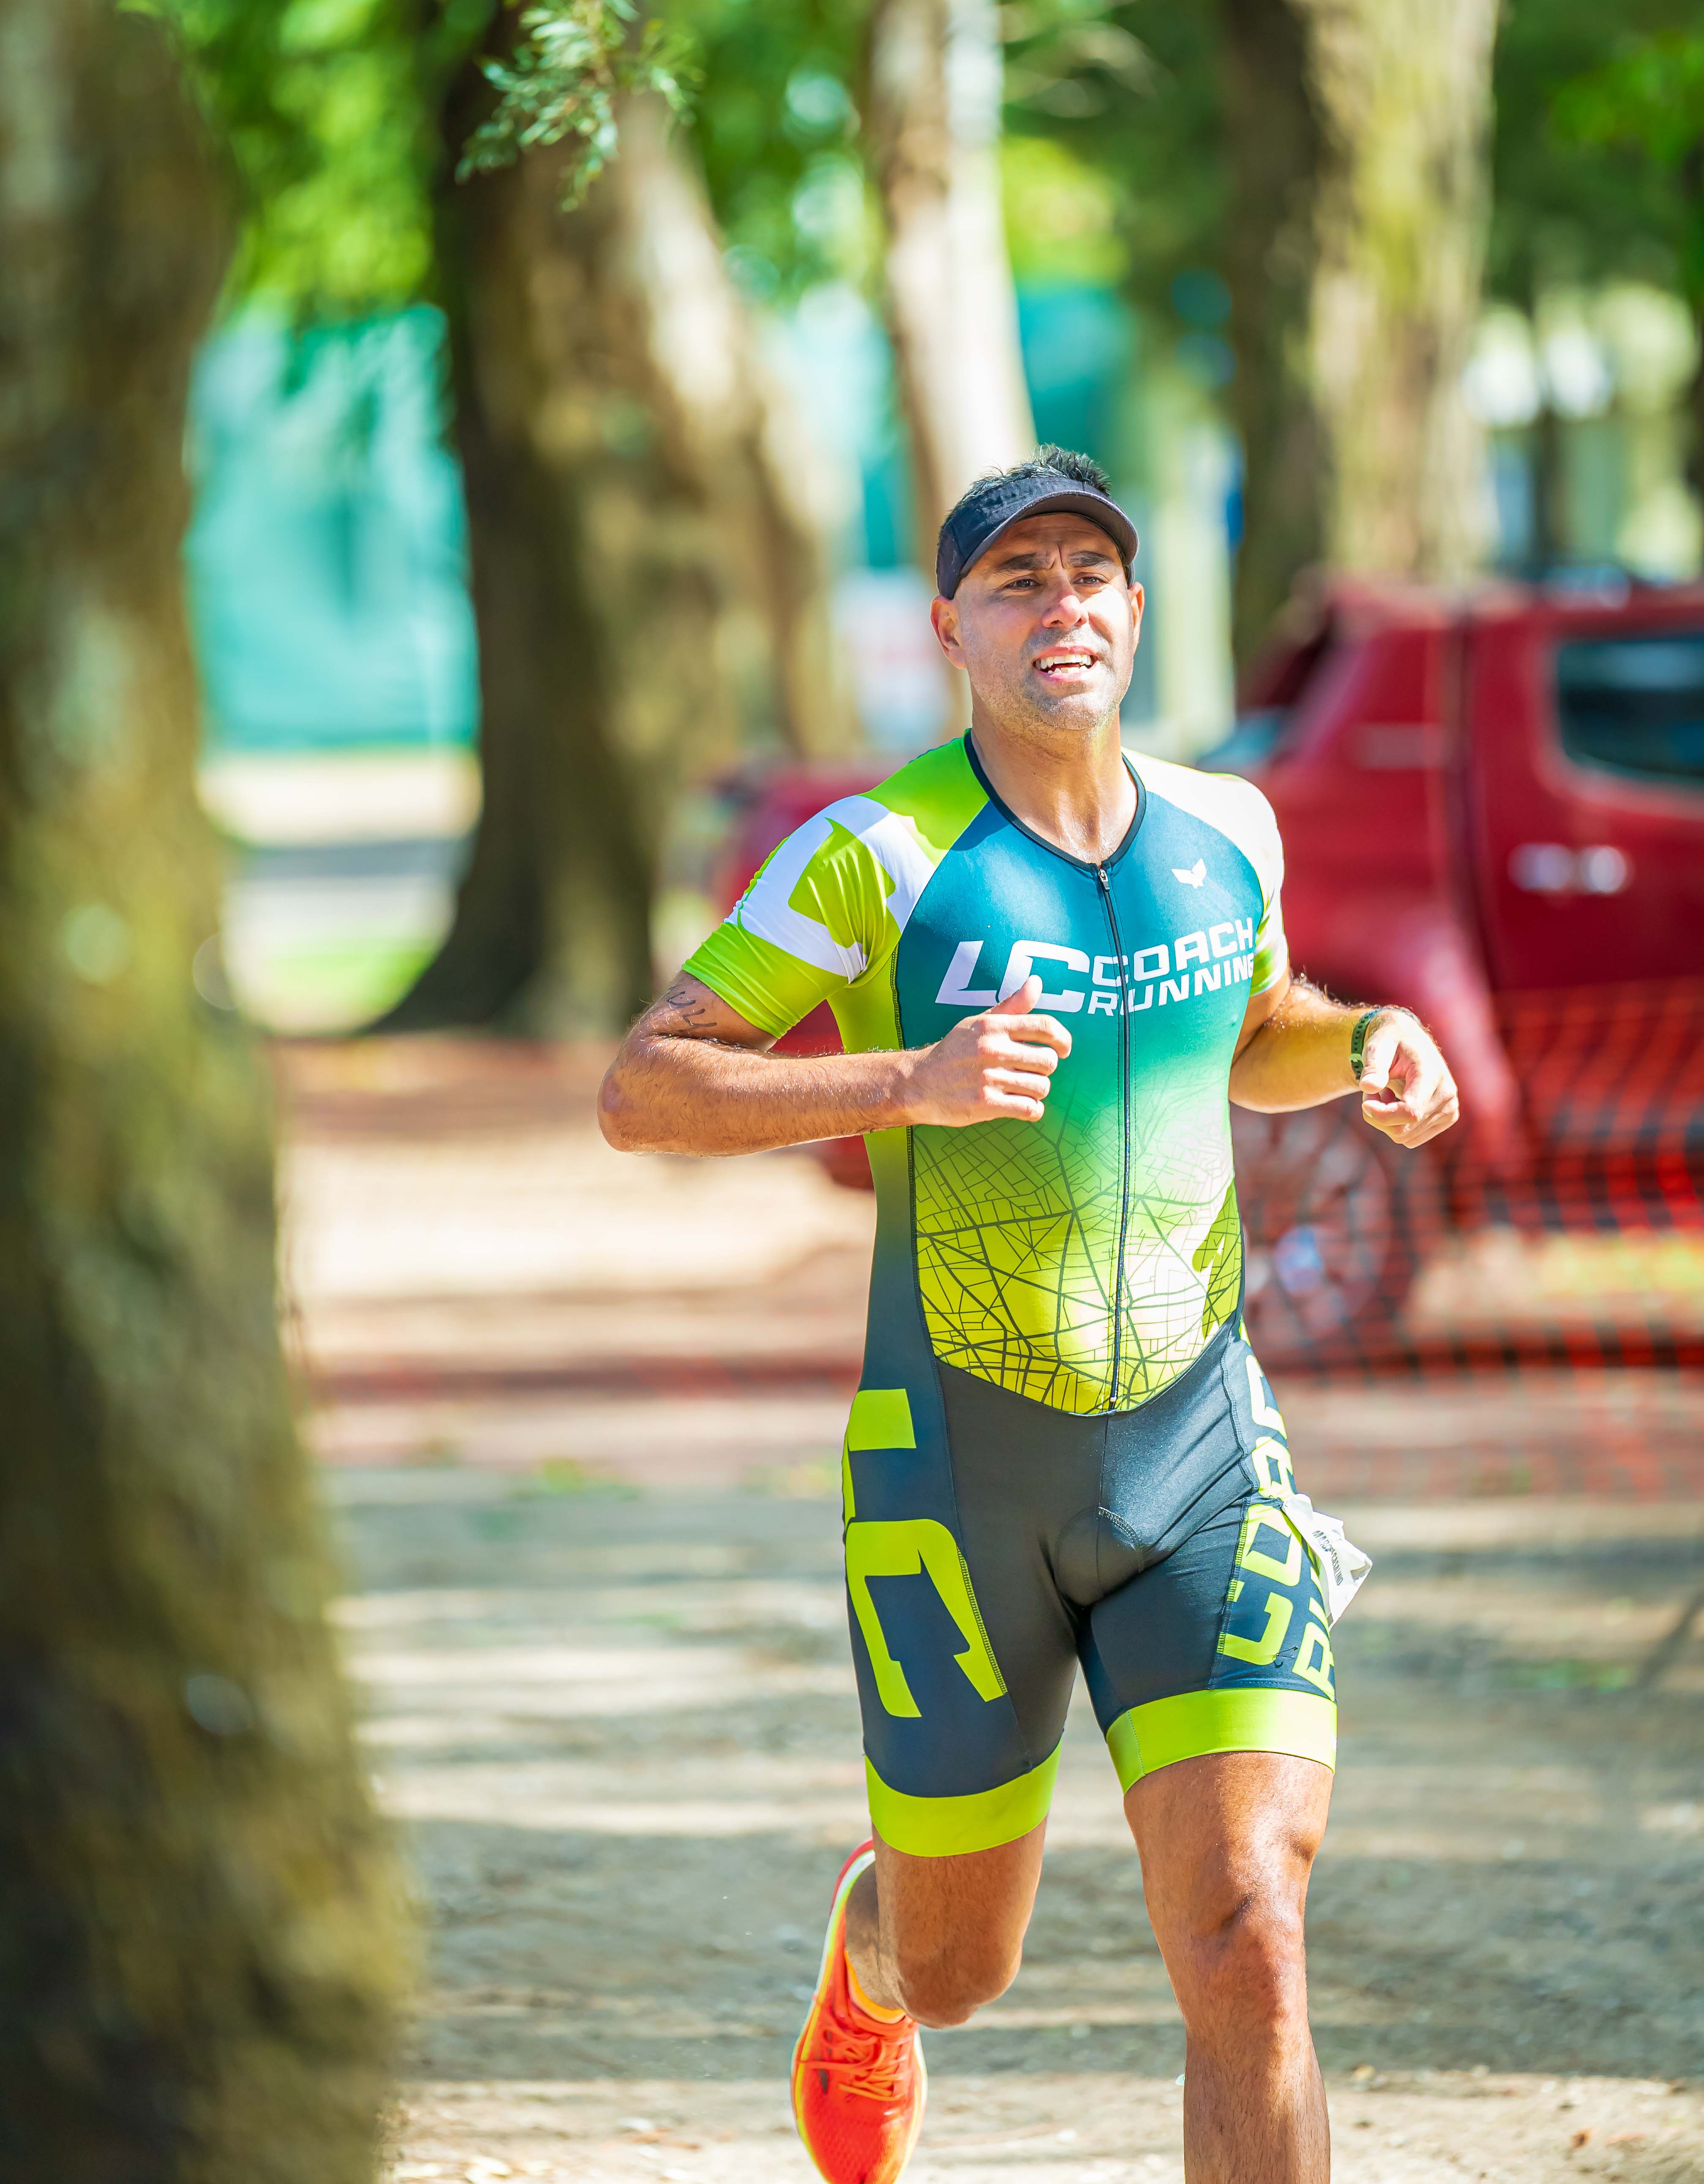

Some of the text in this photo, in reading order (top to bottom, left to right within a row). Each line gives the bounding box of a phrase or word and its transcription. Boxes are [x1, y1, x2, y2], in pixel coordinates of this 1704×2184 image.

[935, 917, 1253, 1013] LC COACH
[1087, 953, 1254, 1017] RUNNING
[1331, 1552, 1344, 1586] CASALINO
